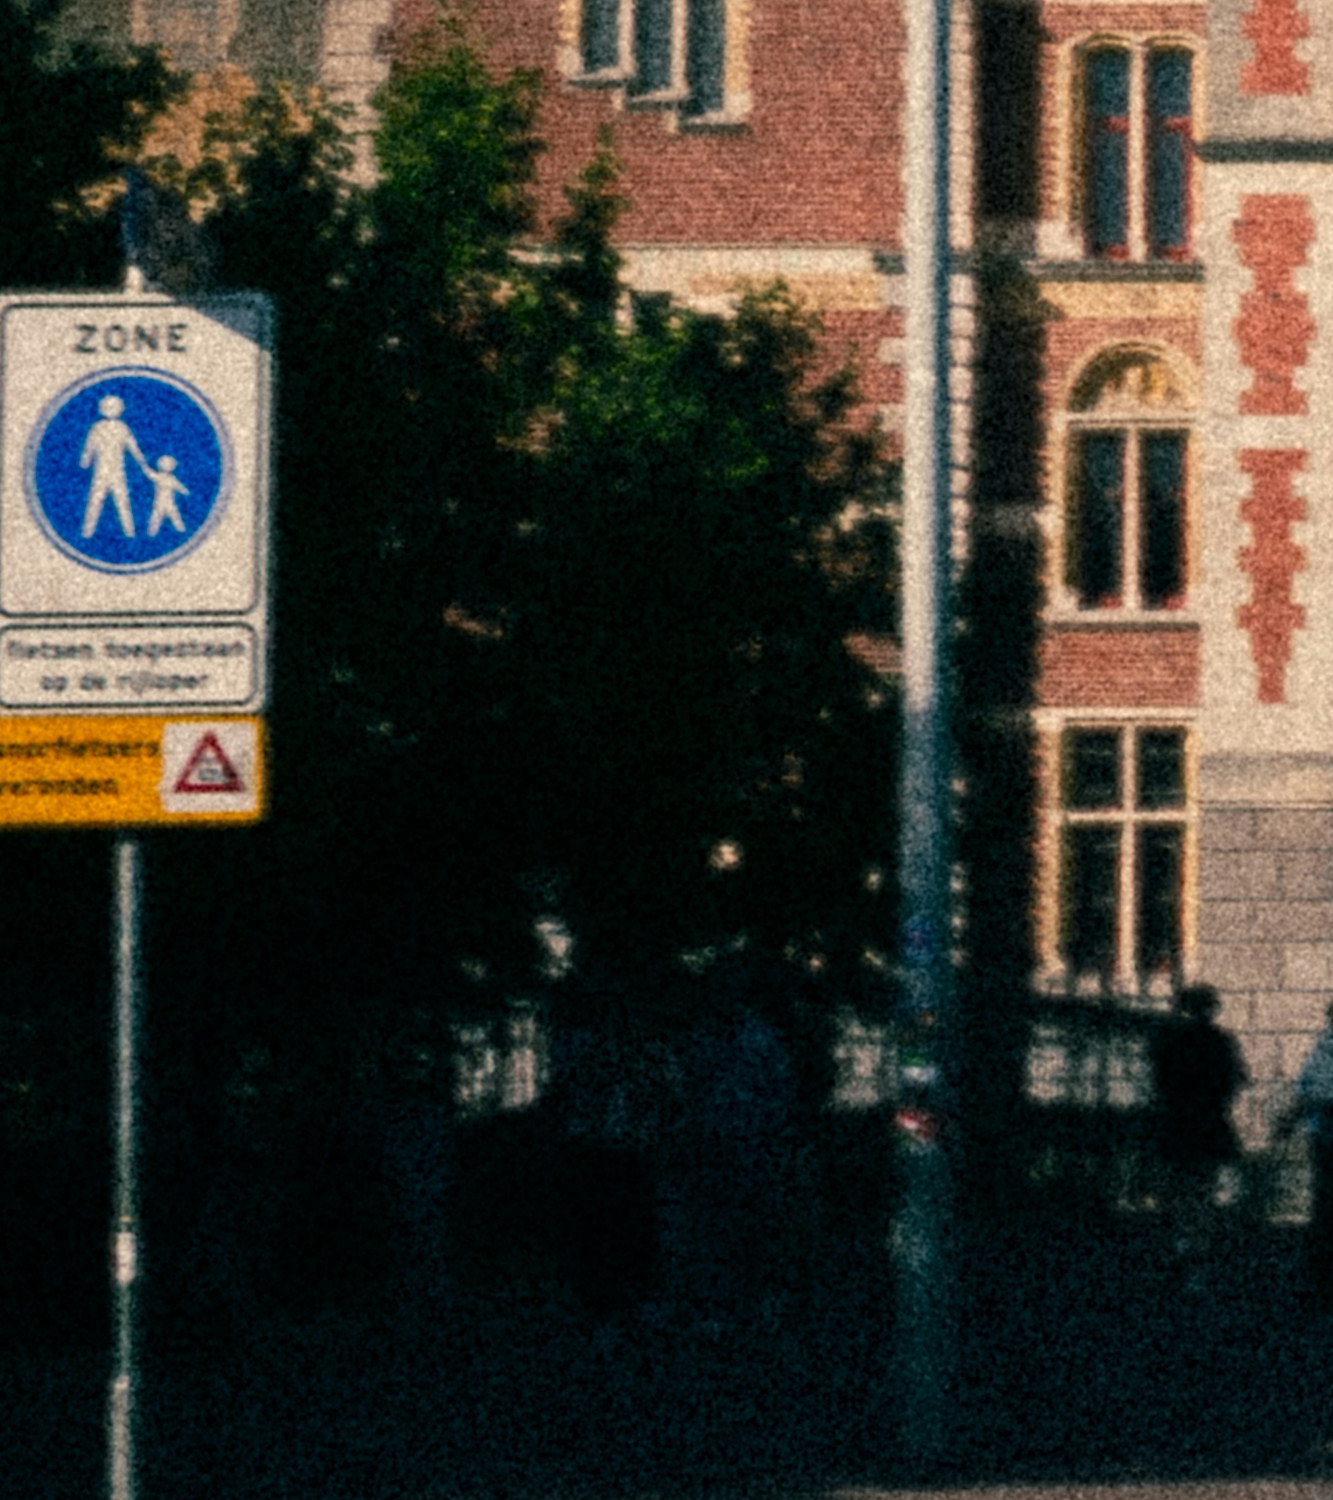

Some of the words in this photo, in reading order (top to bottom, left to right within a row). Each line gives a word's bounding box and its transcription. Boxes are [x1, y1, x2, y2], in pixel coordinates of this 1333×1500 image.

[75, 323, 189, 353] ZONE
[105, 639, 245, 664] toegestaan
[40, 674, 69, 693] op
[80, 672, 107, 692] de
